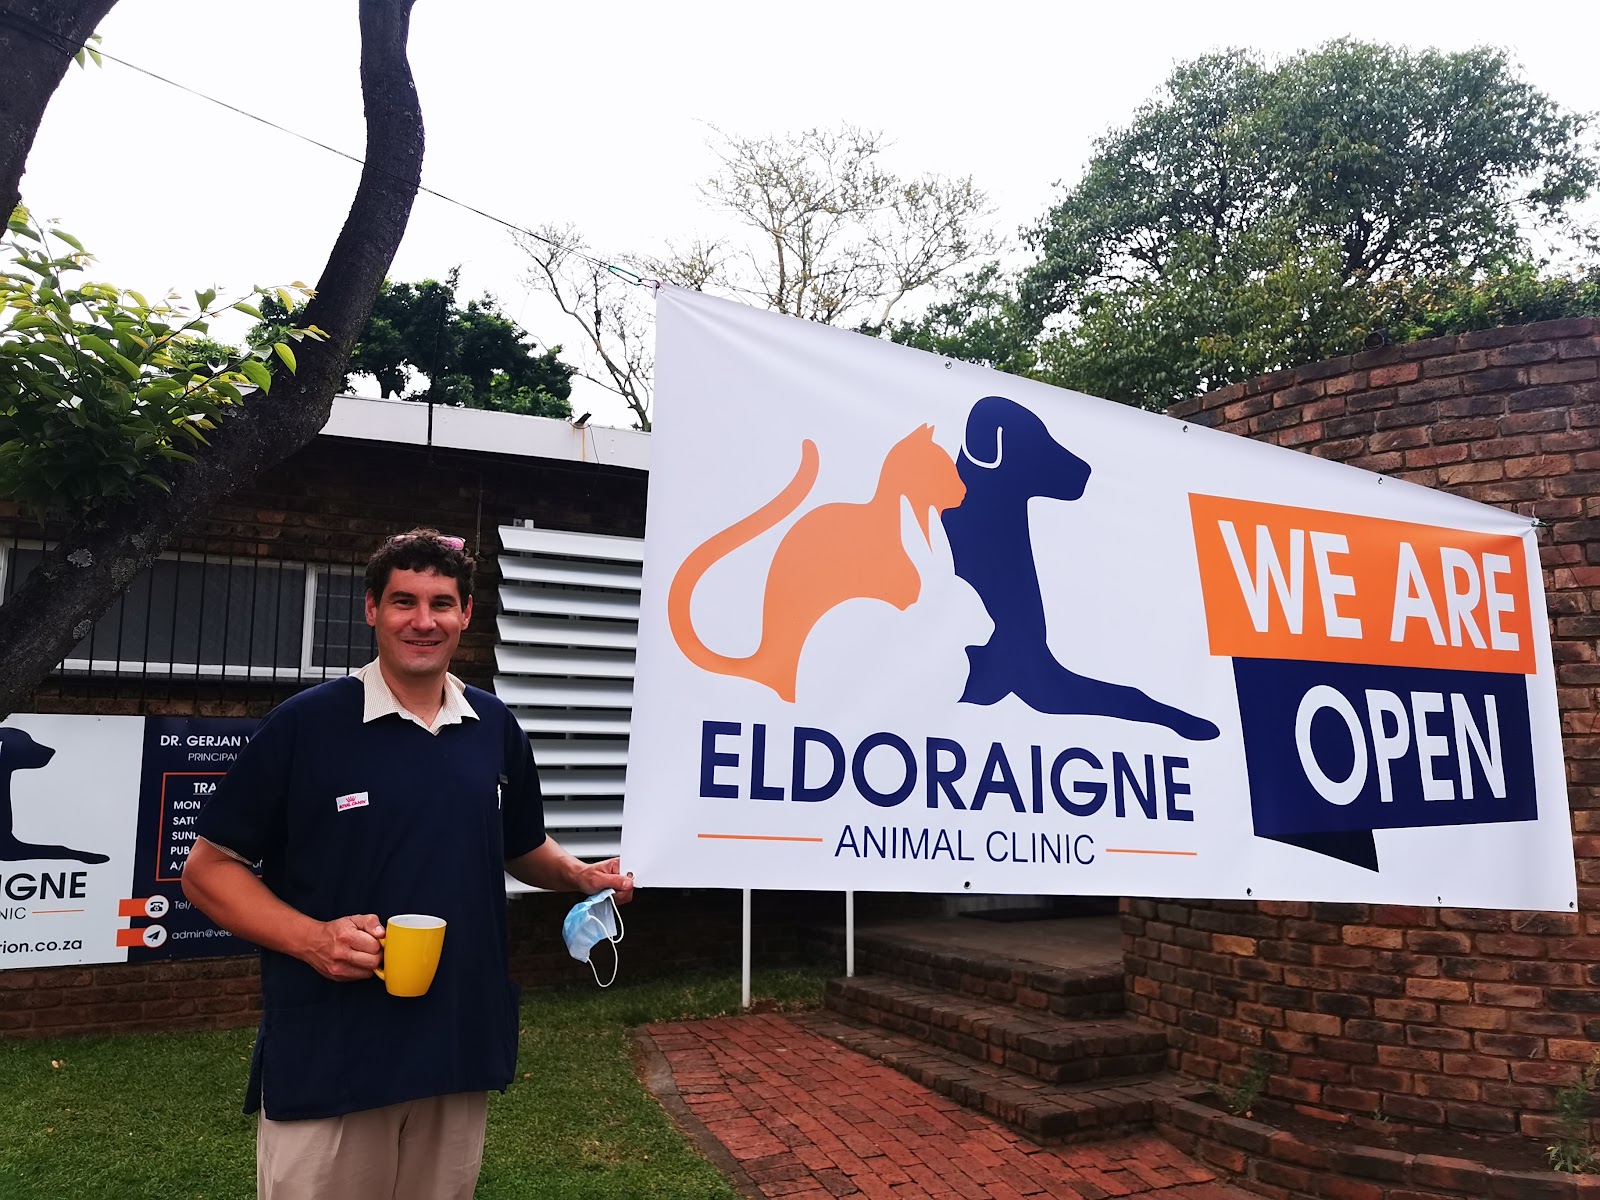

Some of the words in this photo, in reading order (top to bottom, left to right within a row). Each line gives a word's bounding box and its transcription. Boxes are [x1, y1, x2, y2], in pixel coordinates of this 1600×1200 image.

[1217, 519, 1363, 639] WE
[1390, 541, 1521, 652] ARE
[160, 735, 182, 746] DR.
[186, 736, 241, 746] GERJAN
[1295, 684, 1507, 806] OPEN
[700, 720, 1195, 822] ELDORAIGNE
[173, 801, 201, 810] MON
[834, 825, 974, 861] ANIMAL
[986, 831, 1095, 865] CLINIC
[0, 871, 87, 901] GNE
